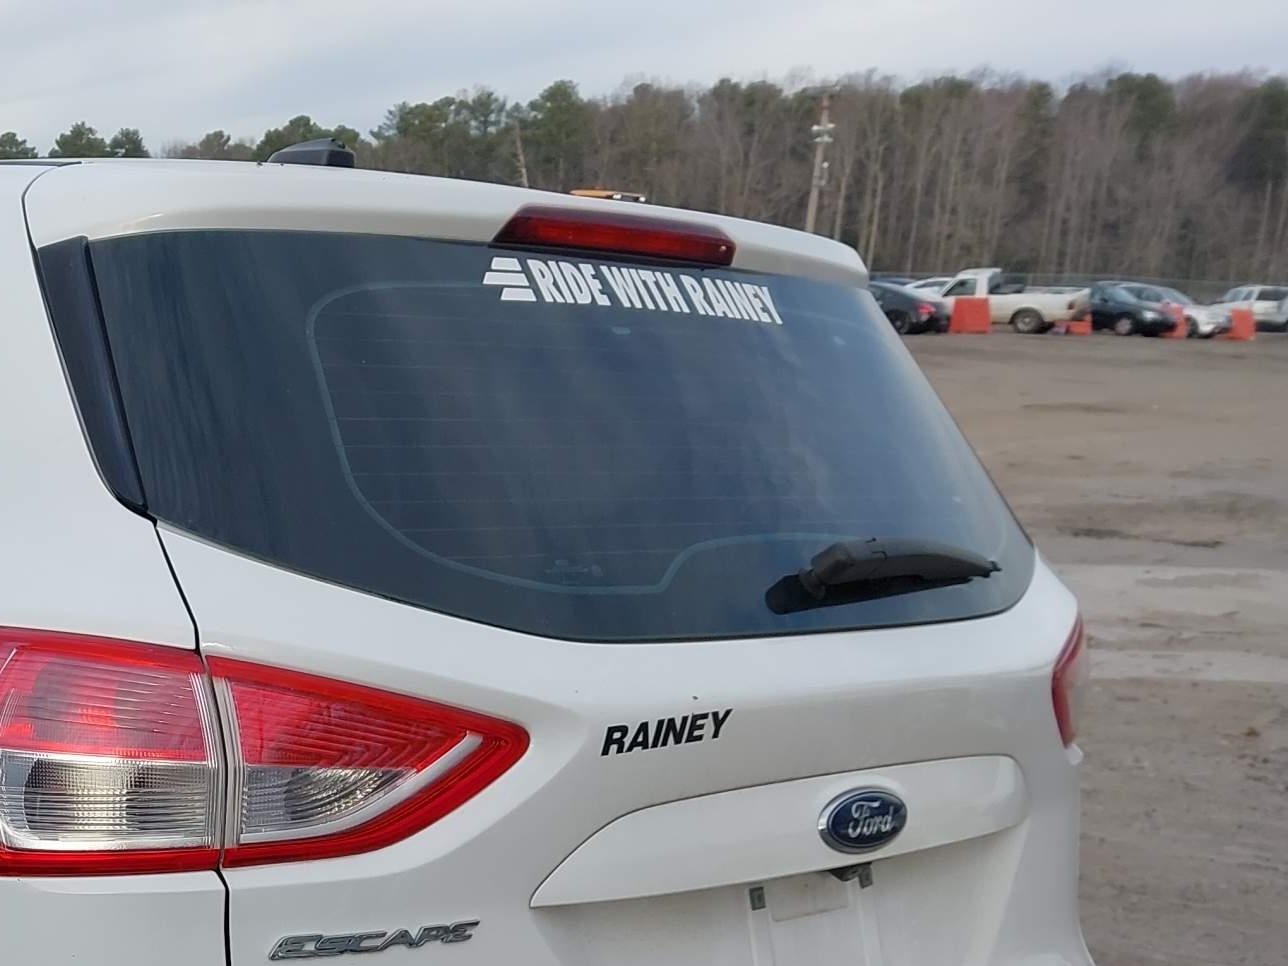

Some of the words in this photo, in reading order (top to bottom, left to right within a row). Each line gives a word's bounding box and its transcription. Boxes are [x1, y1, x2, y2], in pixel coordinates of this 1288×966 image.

[527, 259, 611, 306] RIDE
[599, 265, 690, 313] WITH
[679, 274, 783, 325] RAINEY
[601, 708, 733, 757] RAINEY
[847, 801, 894, 838] Ford
[268, 918, 480, 960] ESCAPE
